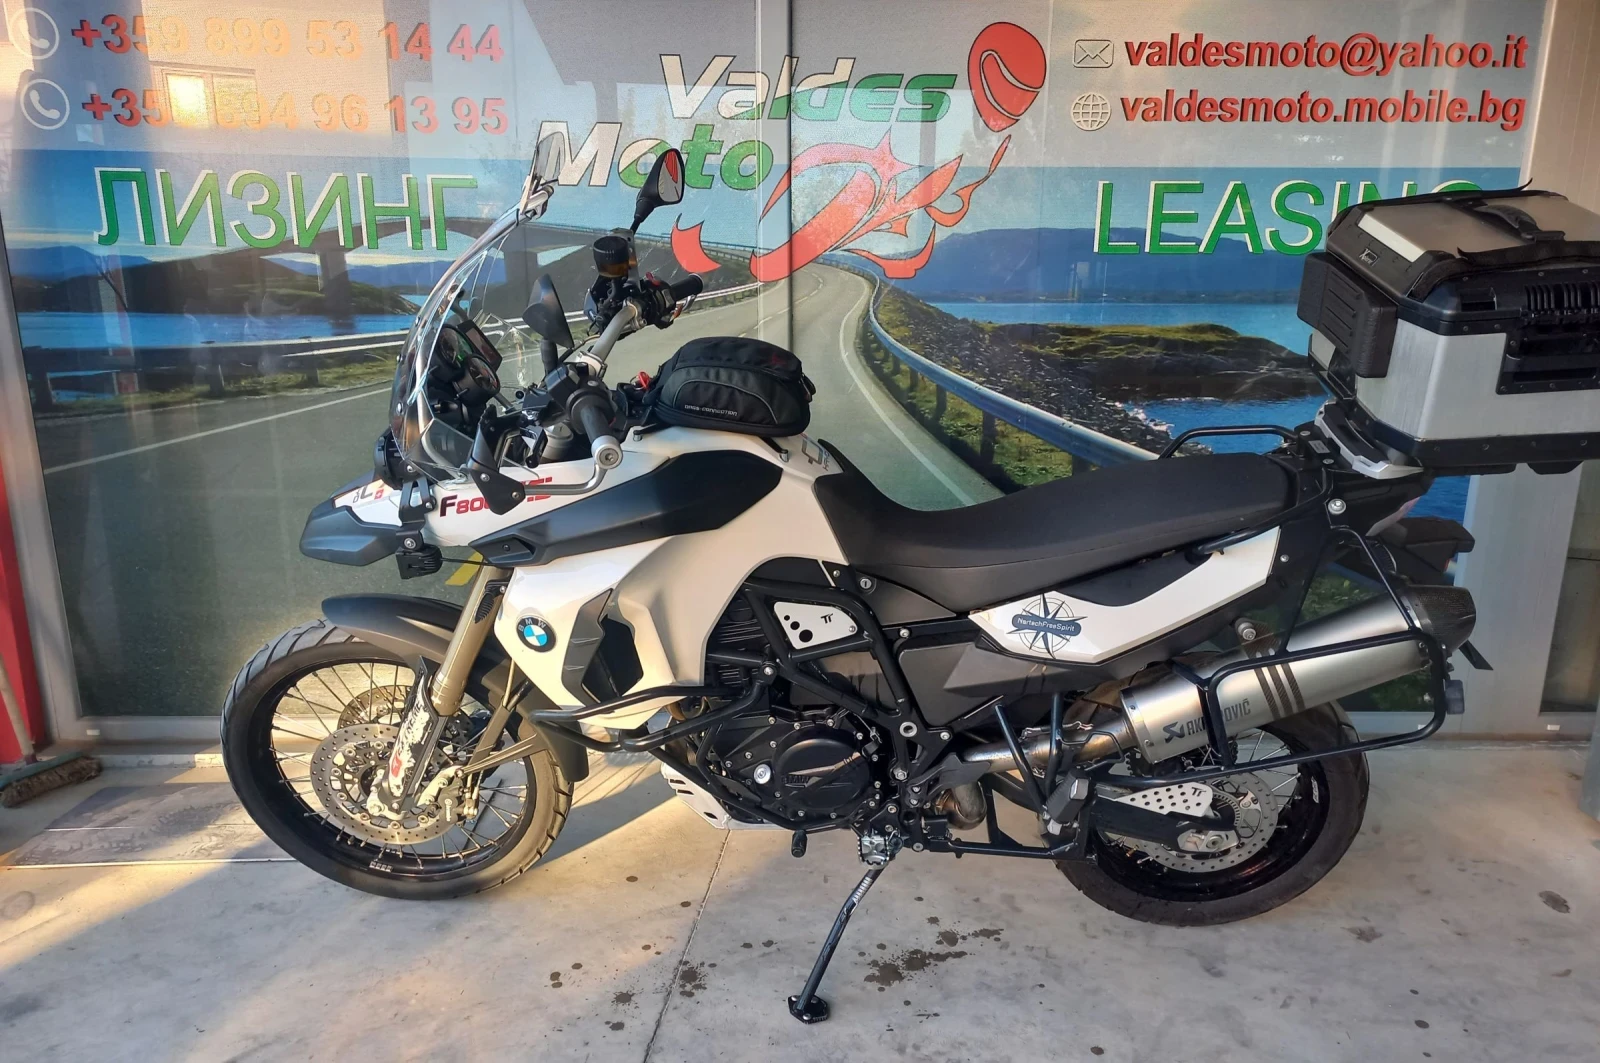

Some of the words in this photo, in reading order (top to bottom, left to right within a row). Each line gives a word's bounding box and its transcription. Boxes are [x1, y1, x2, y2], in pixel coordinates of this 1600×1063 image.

[72, 14, 188, 55] +359
[202, 19, 292, 58] 899
[304, 20, 363, 59] 53
[379, 22, 433, 62] 14
[447, 24, 505, 63] 44
[1124, 33, 1529, 76] valdesmoto@yahoo.it
[82, 87, 209, 130] +35
[313, 94, 368, 132] 96
[384, 95, 440, 134] 13
[452, 96, 510, 135] 95
[659, 53, 957, 123] Valdes
[1120, 89, 1527, 131] valdesmoto.mobile.bg
[536, 121, 774, 190] Moto
[93, 167, 479, 252] ЛИЗИНГ
[1093, 180, 1484, 256] LEAS
[1186, 698, 1251, 736] AKOVIČ
